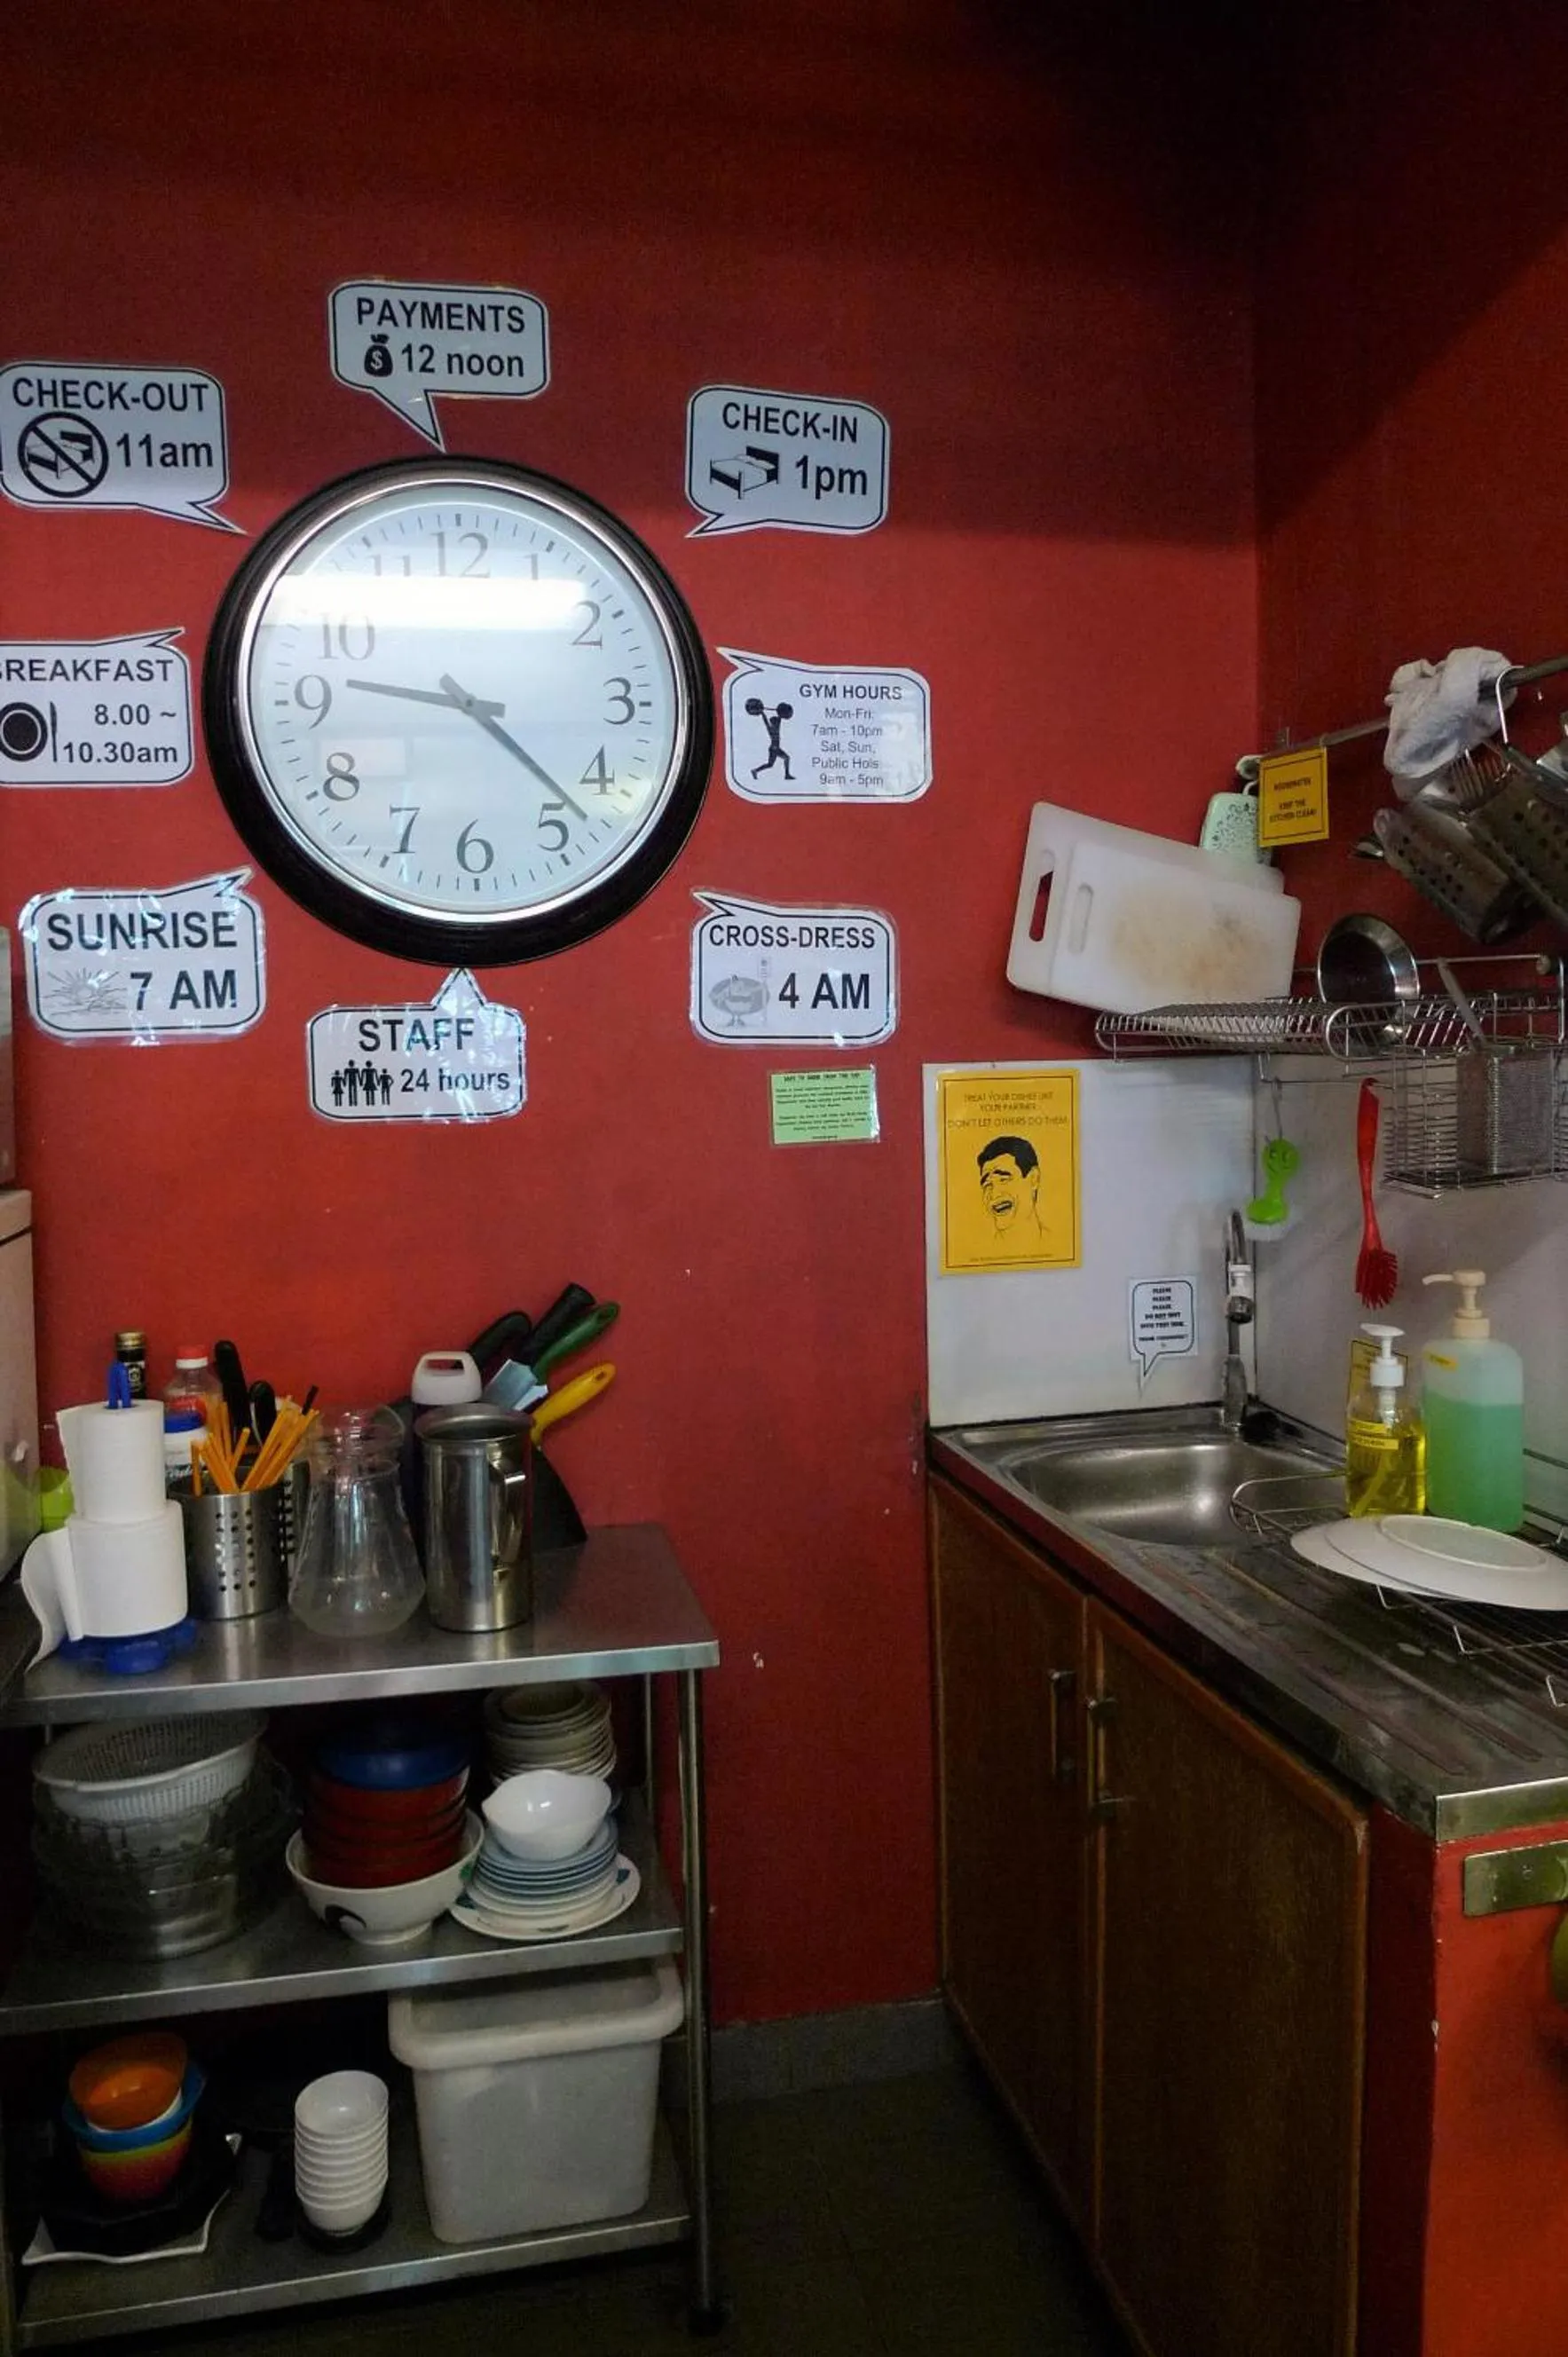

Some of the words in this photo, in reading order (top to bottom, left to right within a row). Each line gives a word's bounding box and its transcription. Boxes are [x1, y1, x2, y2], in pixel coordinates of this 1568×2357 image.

[357, 297, 525, 334] PAYMENTS
[401, 343, 435, 374] 12
[446, 350, 524, 377] noon
[12, 378, 209, 412] CHECK-OUT
[721, 402, 857, 443] CHECK-IN
[116, 434, 214, 469] 11am
[795, 455, 867, 500] 1pm
[431, 532, 491, 578] 12
[317, 614, 375, 660] 10
[572, 601, 603, 647] 2
[0, 659, 174, 682] REAKFAST
[295, 675, 333, 729] 9
[603, 677, 635, 725] 3
[800, 683, 837, 698] GYM
[843, 685, 902, 700] HOURS
[94, 704, 150, 725] 8.00
[812, 724, 838, 737] 7am
[851, 724, 883, 739] 10pm
[63, 742, 177, 763] 10.30am
[812, 757, 848, 769] Public
[821, 740, 844, 753] Sat,
[848, 741, 876, 754] Sun,
[322, 753, 359, 801] 8
[579, 745, 615, 796] 4
[820, 773, 846, 785] 9am
[858, 774, 884, 787] 5pm
[390, 807, 421, 855] 7
[537, 801, 570, 852] 5
[456, 820, 494, 874] 6
[48, 911, 237, 950] SUNRISE
[710, 925, 875, 949] CROSS-DRESS
[130, 972, 152, 1011] 7
[169, 969, 237, 1009] AM
[779, 973, 799, 1009] 4
[811, 974, 870, 1009] AM
[359, 1019, 474, 1052] STAFF
[400, 1069, 429, 1092] 24
[439, 1068, 510, 1092] hours
[978, 1118, 991, 1127] LET
[1028, 1116, 1043, 1125] DO
